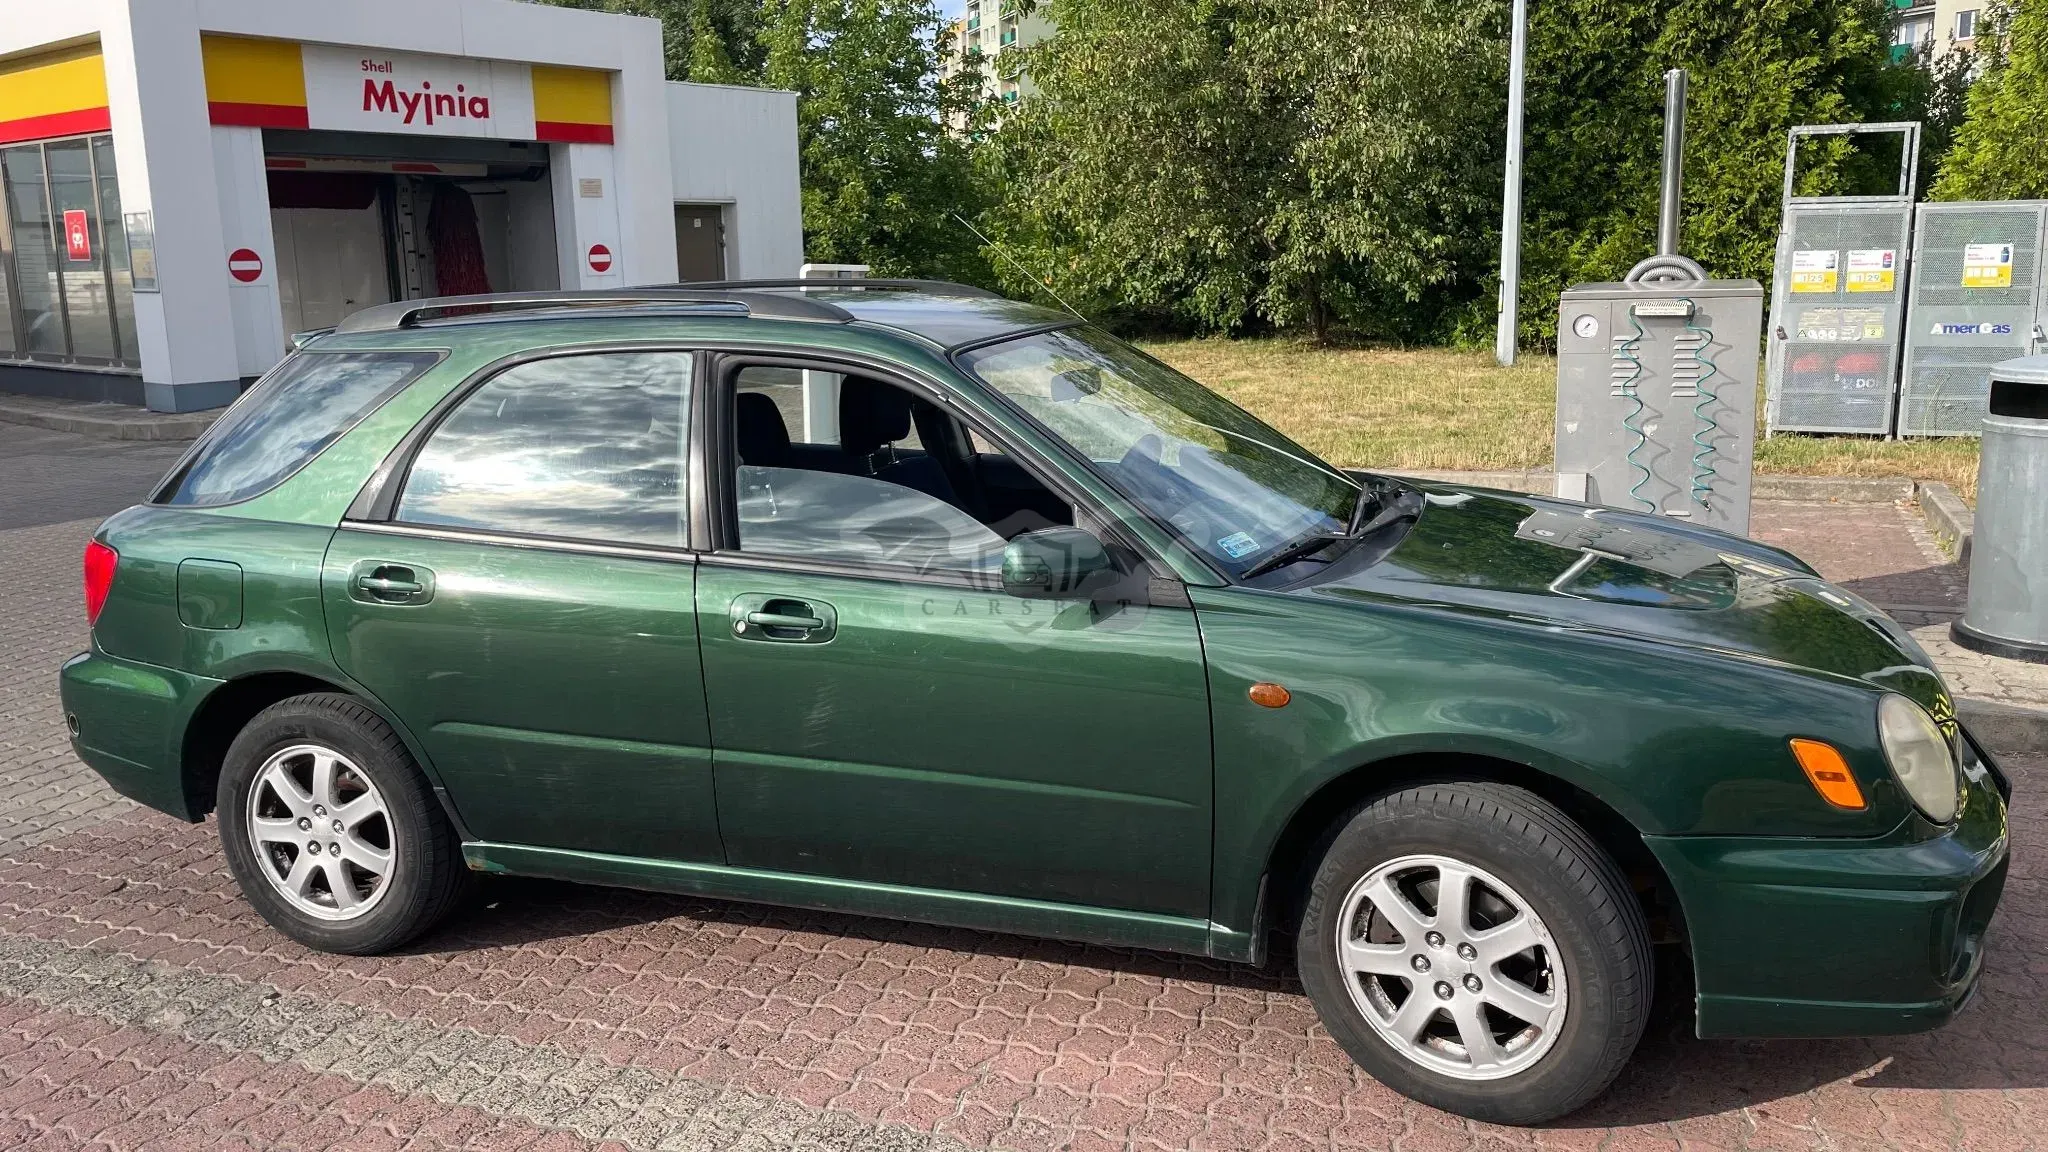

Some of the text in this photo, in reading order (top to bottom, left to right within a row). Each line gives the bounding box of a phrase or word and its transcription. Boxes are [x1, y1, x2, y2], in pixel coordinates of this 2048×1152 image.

[361, 59, 393, 74] Shell
[363, 78, 490, 126] Myjnia
[1930, 322, 2012, 335] AmeriGas
